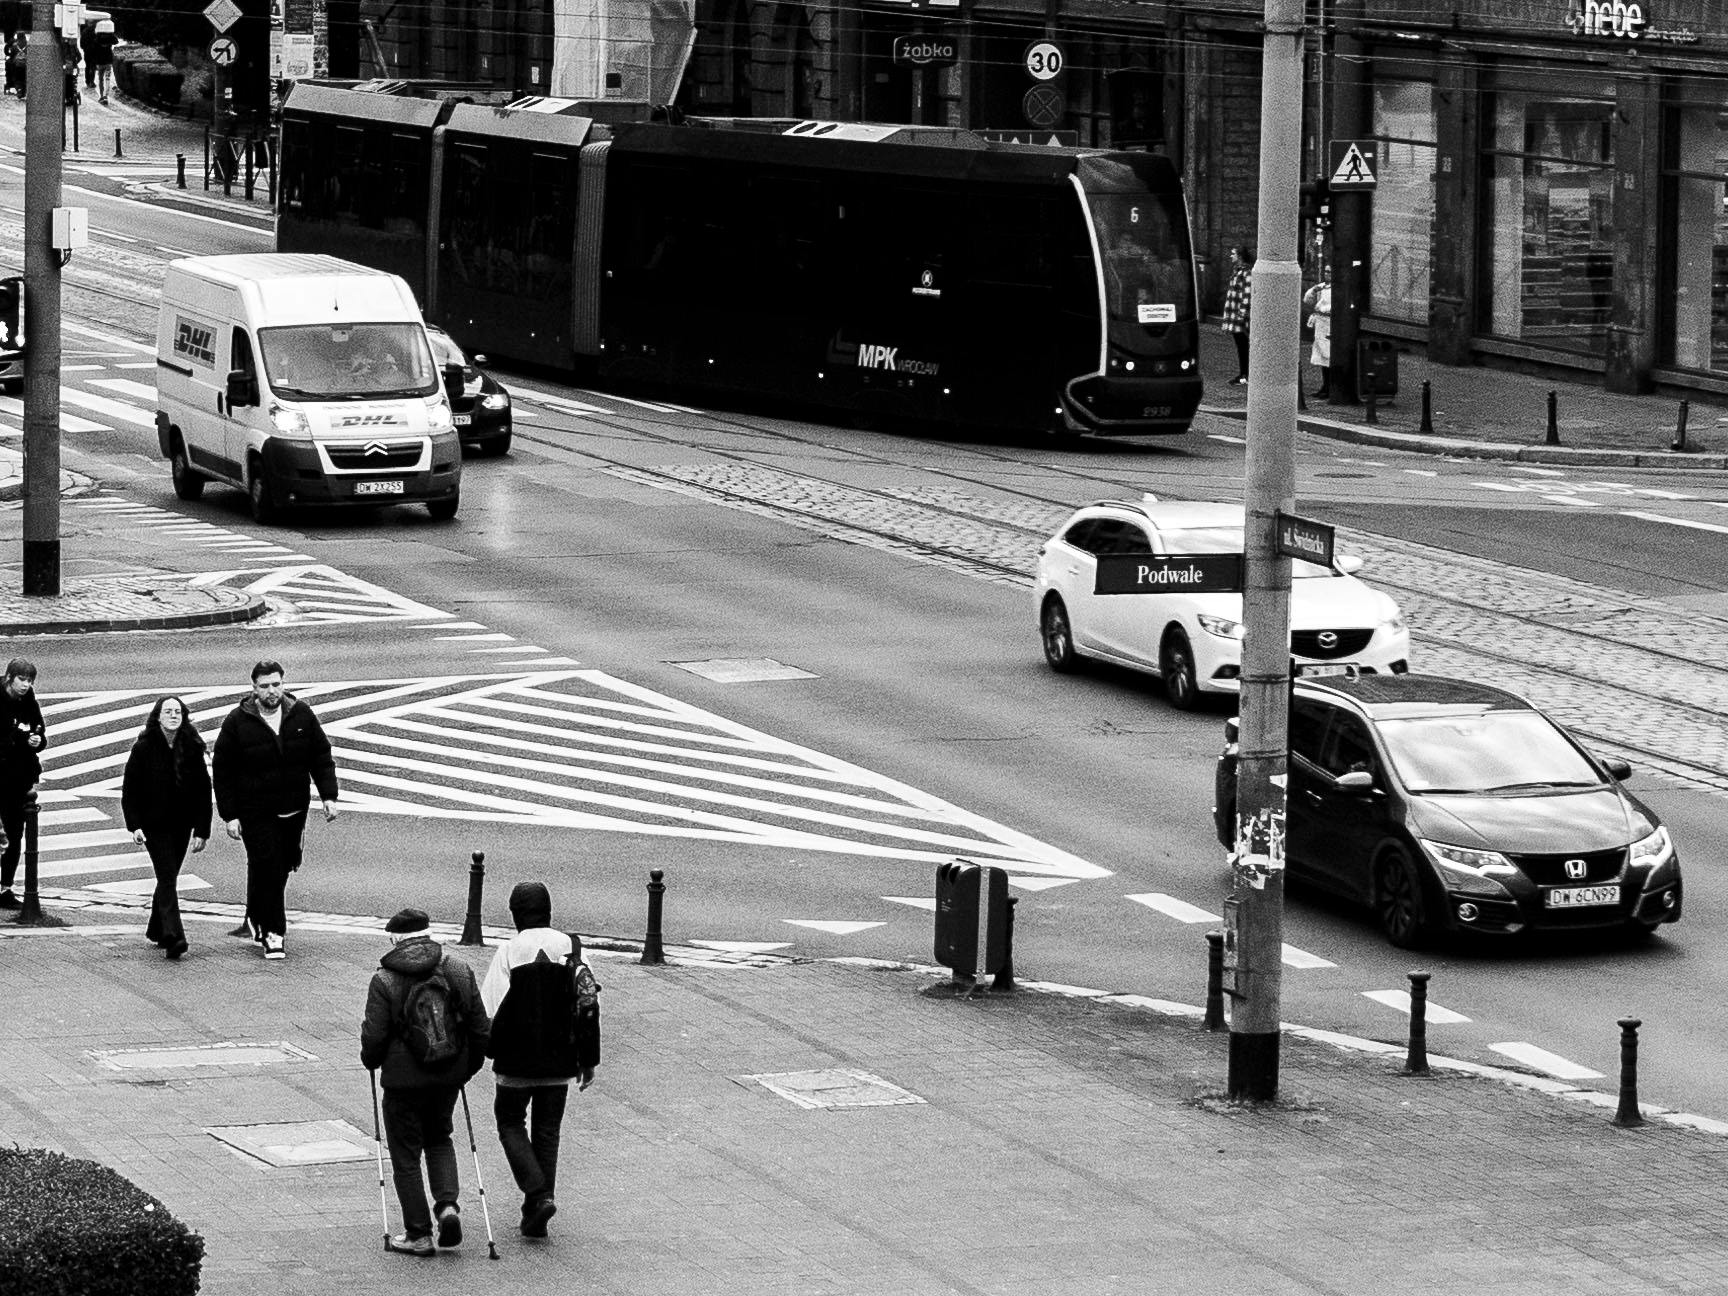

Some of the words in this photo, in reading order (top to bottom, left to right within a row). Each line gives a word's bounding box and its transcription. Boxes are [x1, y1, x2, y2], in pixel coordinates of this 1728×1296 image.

[903, 42, 953, 58] żabka
[1030, 51, 1060, 74] 30
[1130, 207, 1139, 223] 6
[178, 323, 213, 362] DHL
[858, 343, 899, 371] MPK
[341, 414, 397, 427] DHL
[1136, 565, 1204, 584] Podwale
